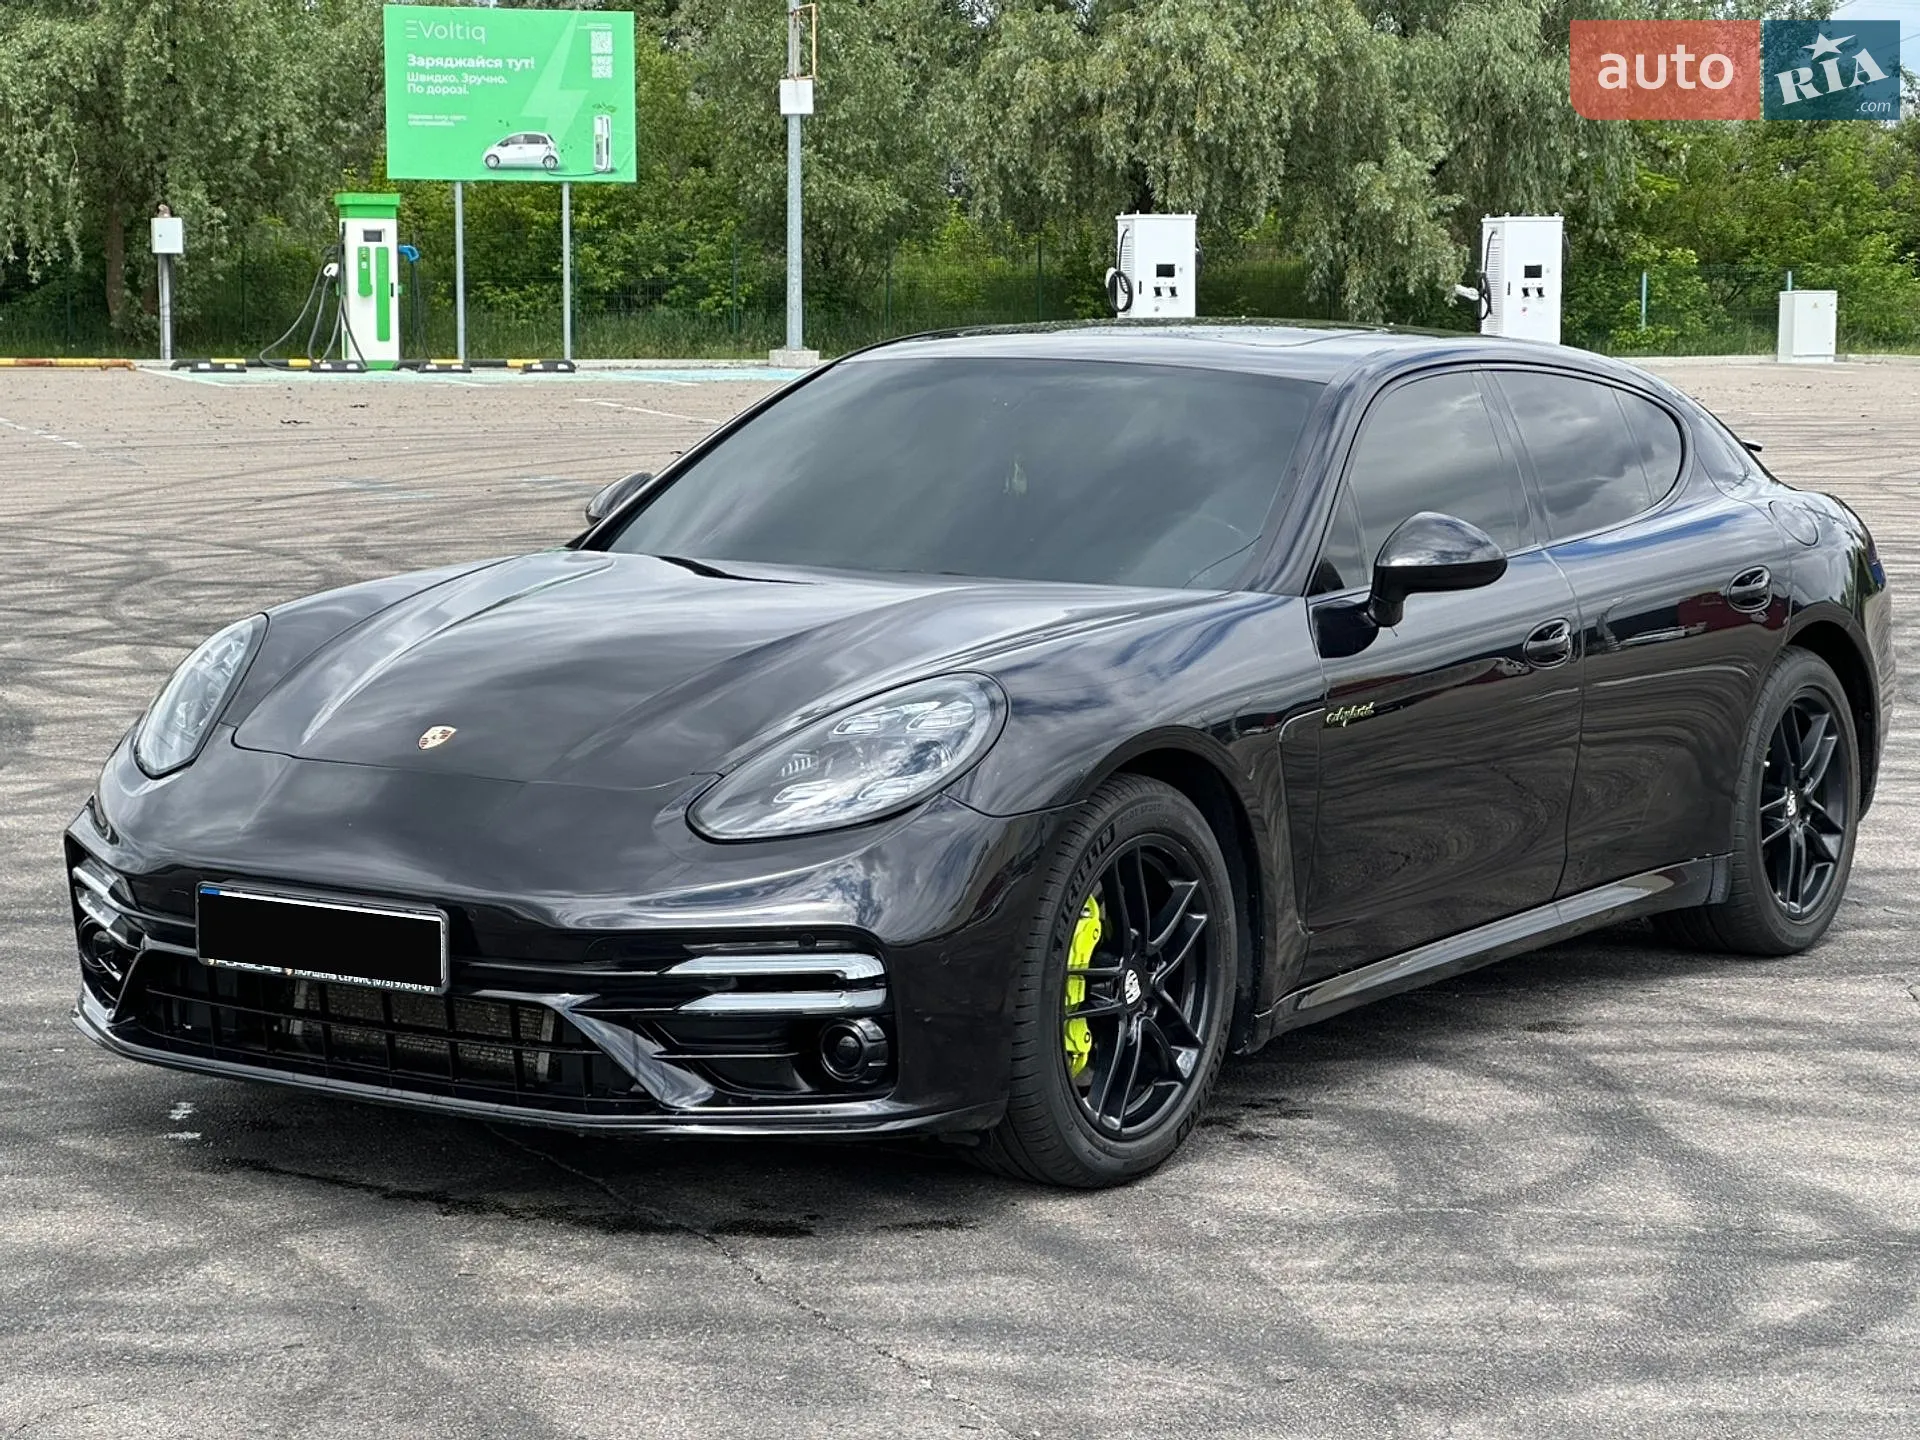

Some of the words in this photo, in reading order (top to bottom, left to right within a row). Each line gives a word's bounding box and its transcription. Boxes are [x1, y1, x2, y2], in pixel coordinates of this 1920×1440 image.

[405, 19, 486, 45] EVoltiq
[407, 53, 503, 70] Заряджайся
[505, 56, 535, 72] тут!
[406, 72, 459, 84] Швидко.
[461, 73, 508, 85] Зручно.
[407, 83, 424, 94] По
[426, 84, 469, 96] дорозі.
